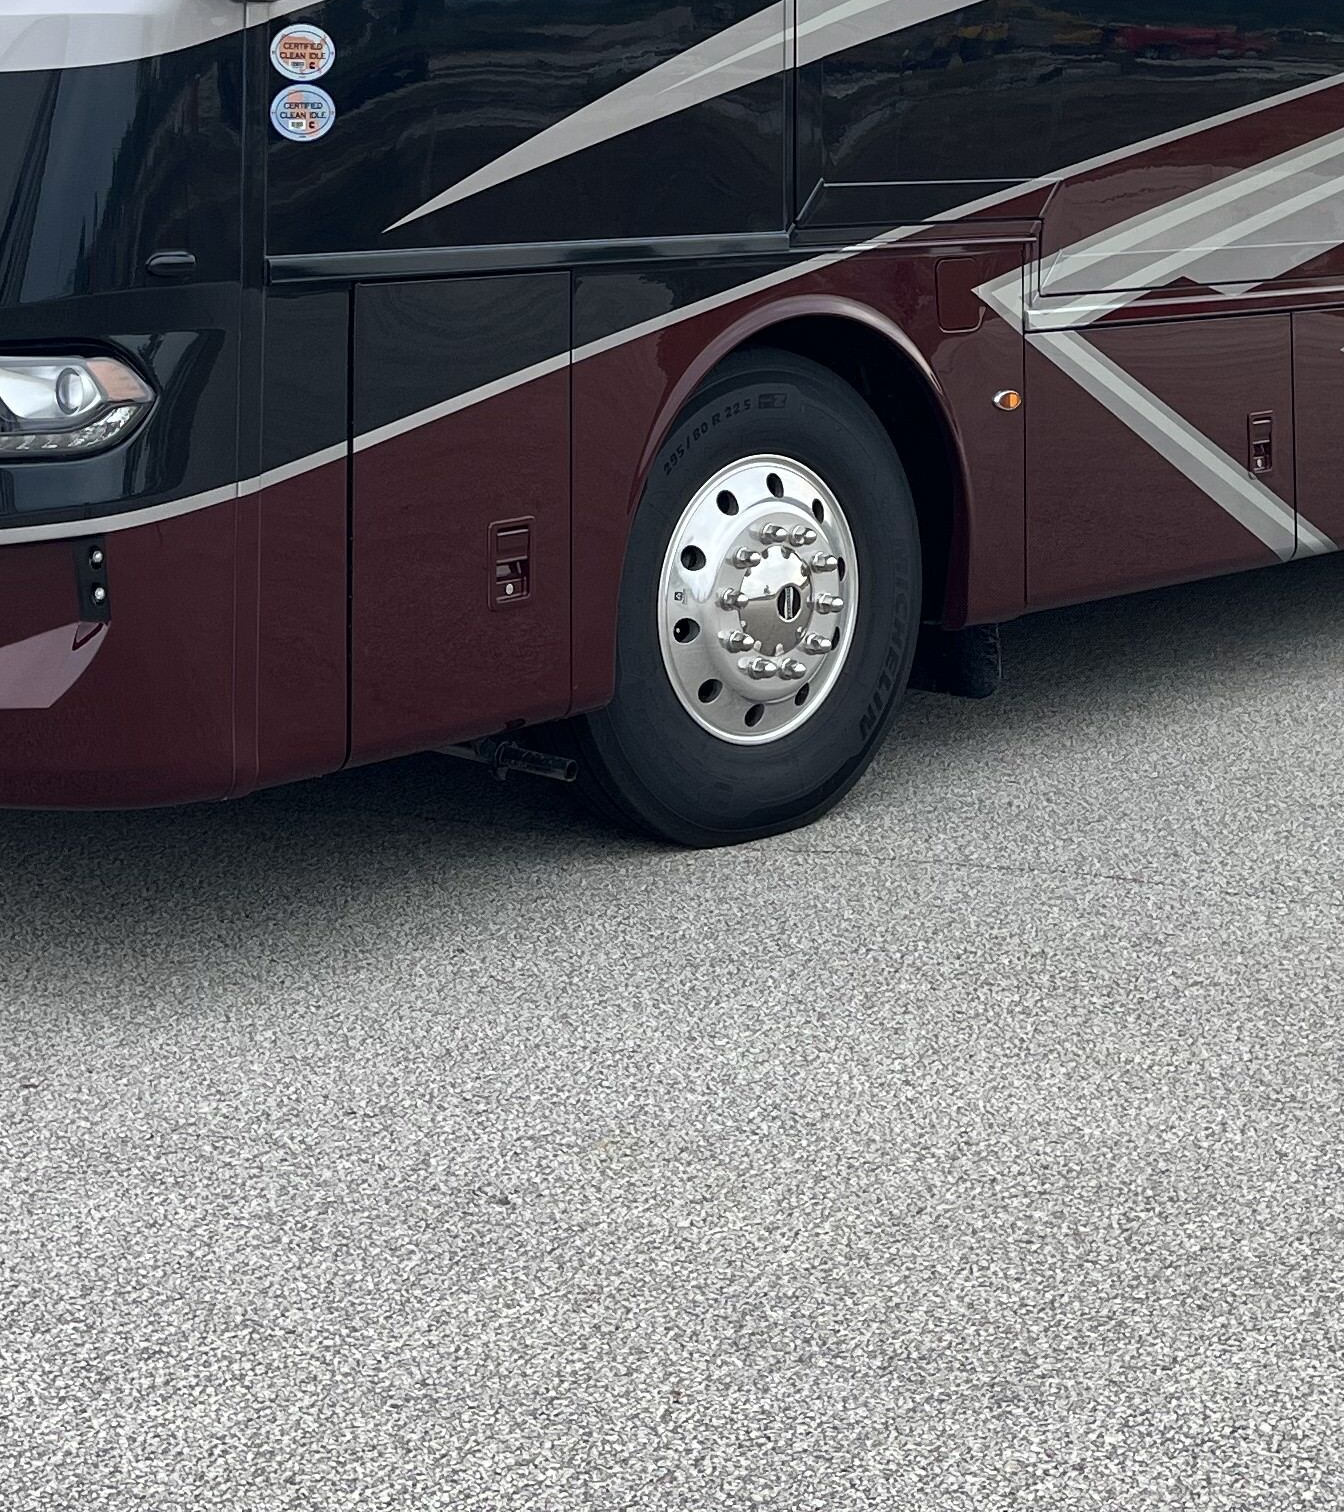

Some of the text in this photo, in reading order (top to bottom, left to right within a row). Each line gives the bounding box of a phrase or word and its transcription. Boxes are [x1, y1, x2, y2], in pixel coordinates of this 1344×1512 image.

[282, 42, 324, 50] CERTIFIED
[279, 51, 327, 60] CLEAN IDLE
[283, 101, 324, 110] CERTIFIED
[279, 111, 327, 120] CLEAN IDLE
